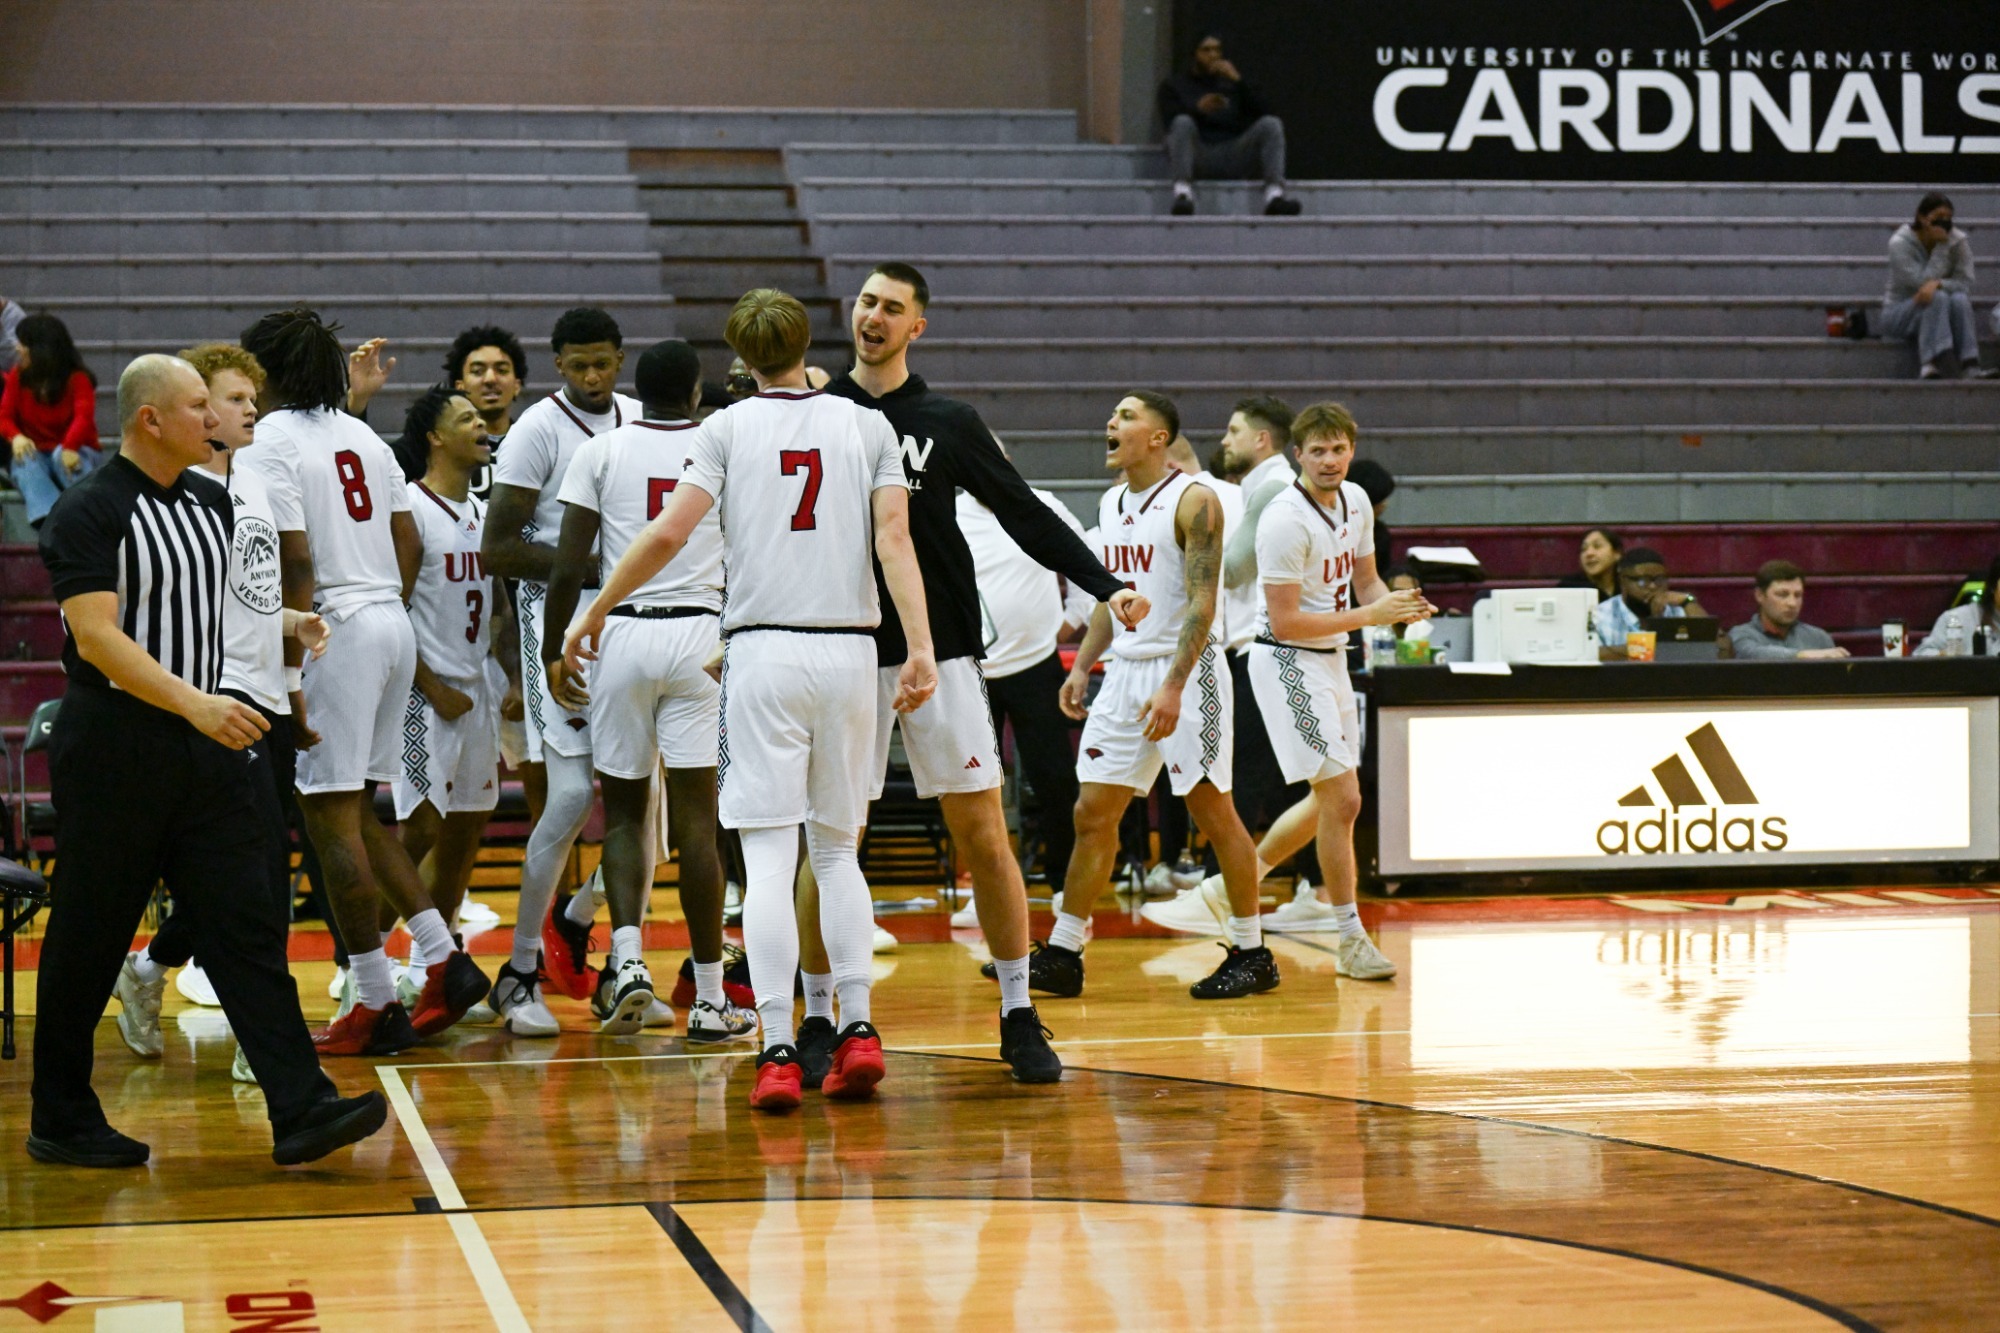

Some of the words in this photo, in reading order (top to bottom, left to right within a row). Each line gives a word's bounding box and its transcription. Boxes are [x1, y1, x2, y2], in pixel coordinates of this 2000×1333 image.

[1376, 47, 1577, 67] UNIVERSITY
[1596, 48, 1634, 68] OF
[1655, 49, 1711, 68] THE
[1731, 50, 1913, 70] INCARNATE
[1373, 67, 2000, 153] CARDINALS
[335, 449, 373, 522] 8
[780, 449, 824, 531] 7
[236, 527, 247, 553] LIVE
[245, 522, 278, 546] HIGHER
[1104, 544, 1154, 573] UIW
[238, 582, 270, 608] VERSO
[465, 589, 484, 644] 3
[1596, 806, 1789, 856] adidas
